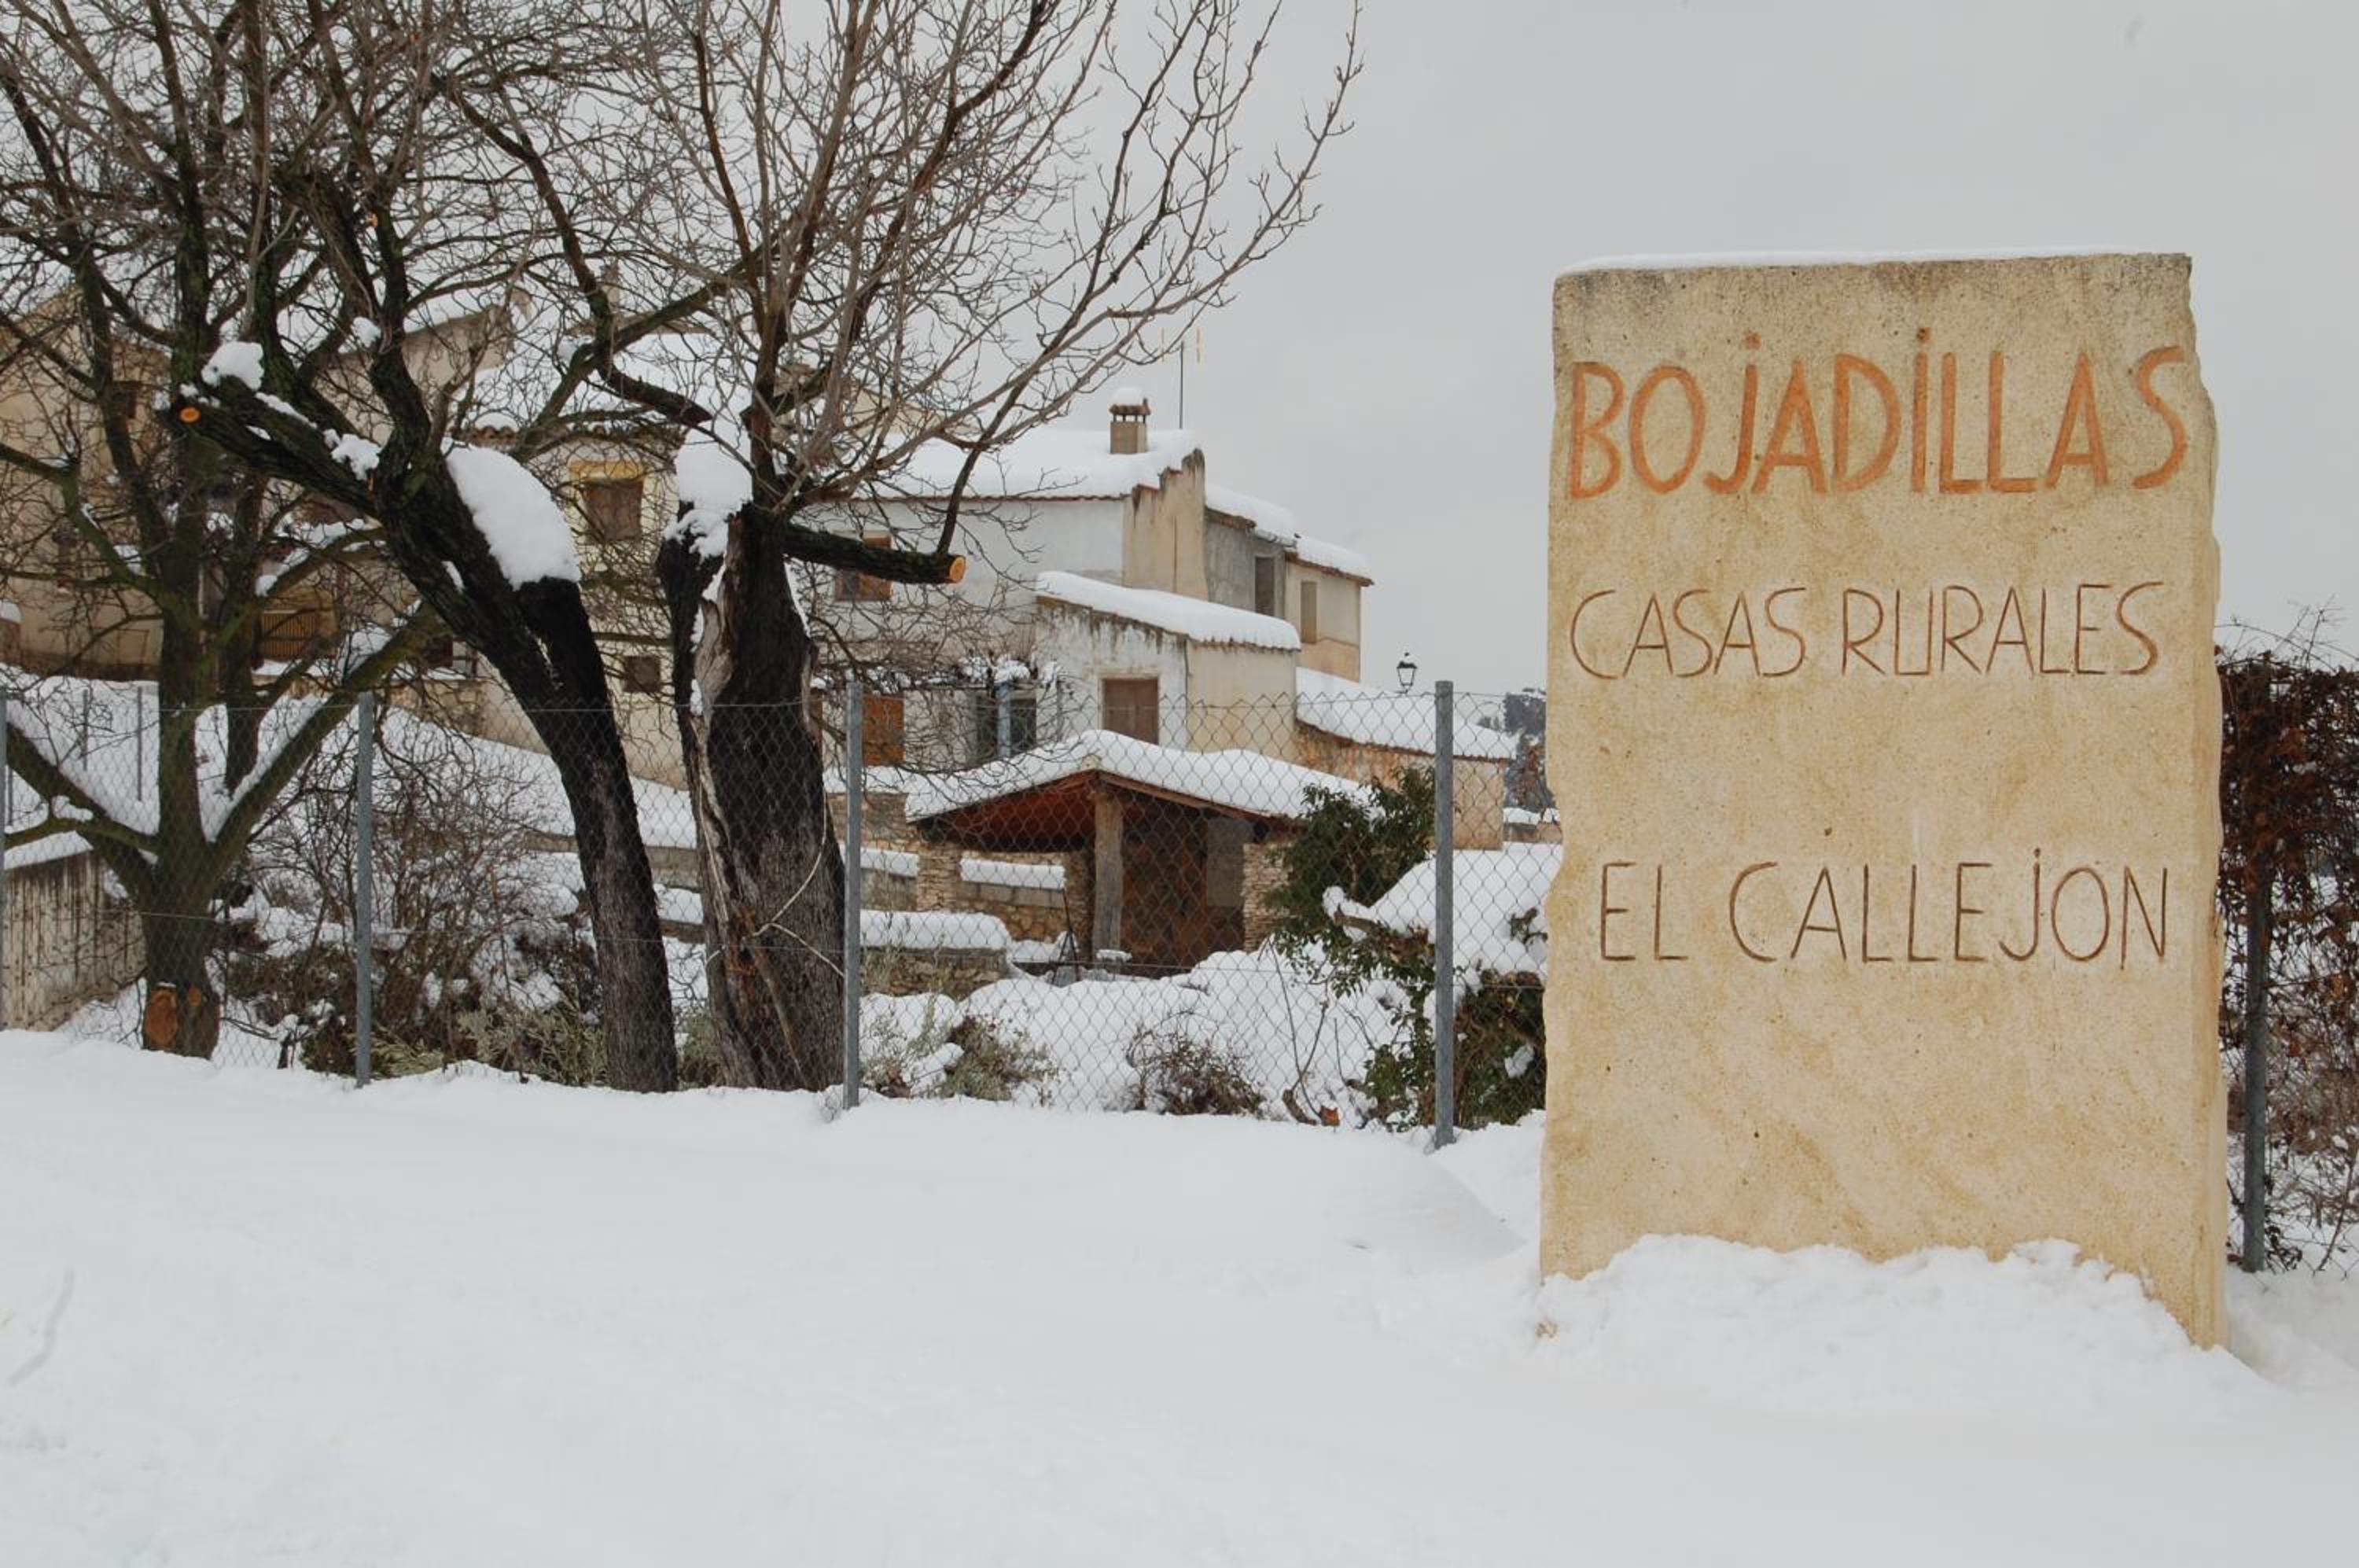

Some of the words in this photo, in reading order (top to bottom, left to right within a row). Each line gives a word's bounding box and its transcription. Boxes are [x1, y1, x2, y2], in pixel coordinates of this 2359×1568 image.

[1570, 326, 2188, 499] BOJADILLAS
[1570, 587, 1807, 679] CASAS
[1842, 581, 2164, 676] RURALES
[1599, 861, 1689, 962] EL
[1729, 848, 2169, 970] CALLEJON
